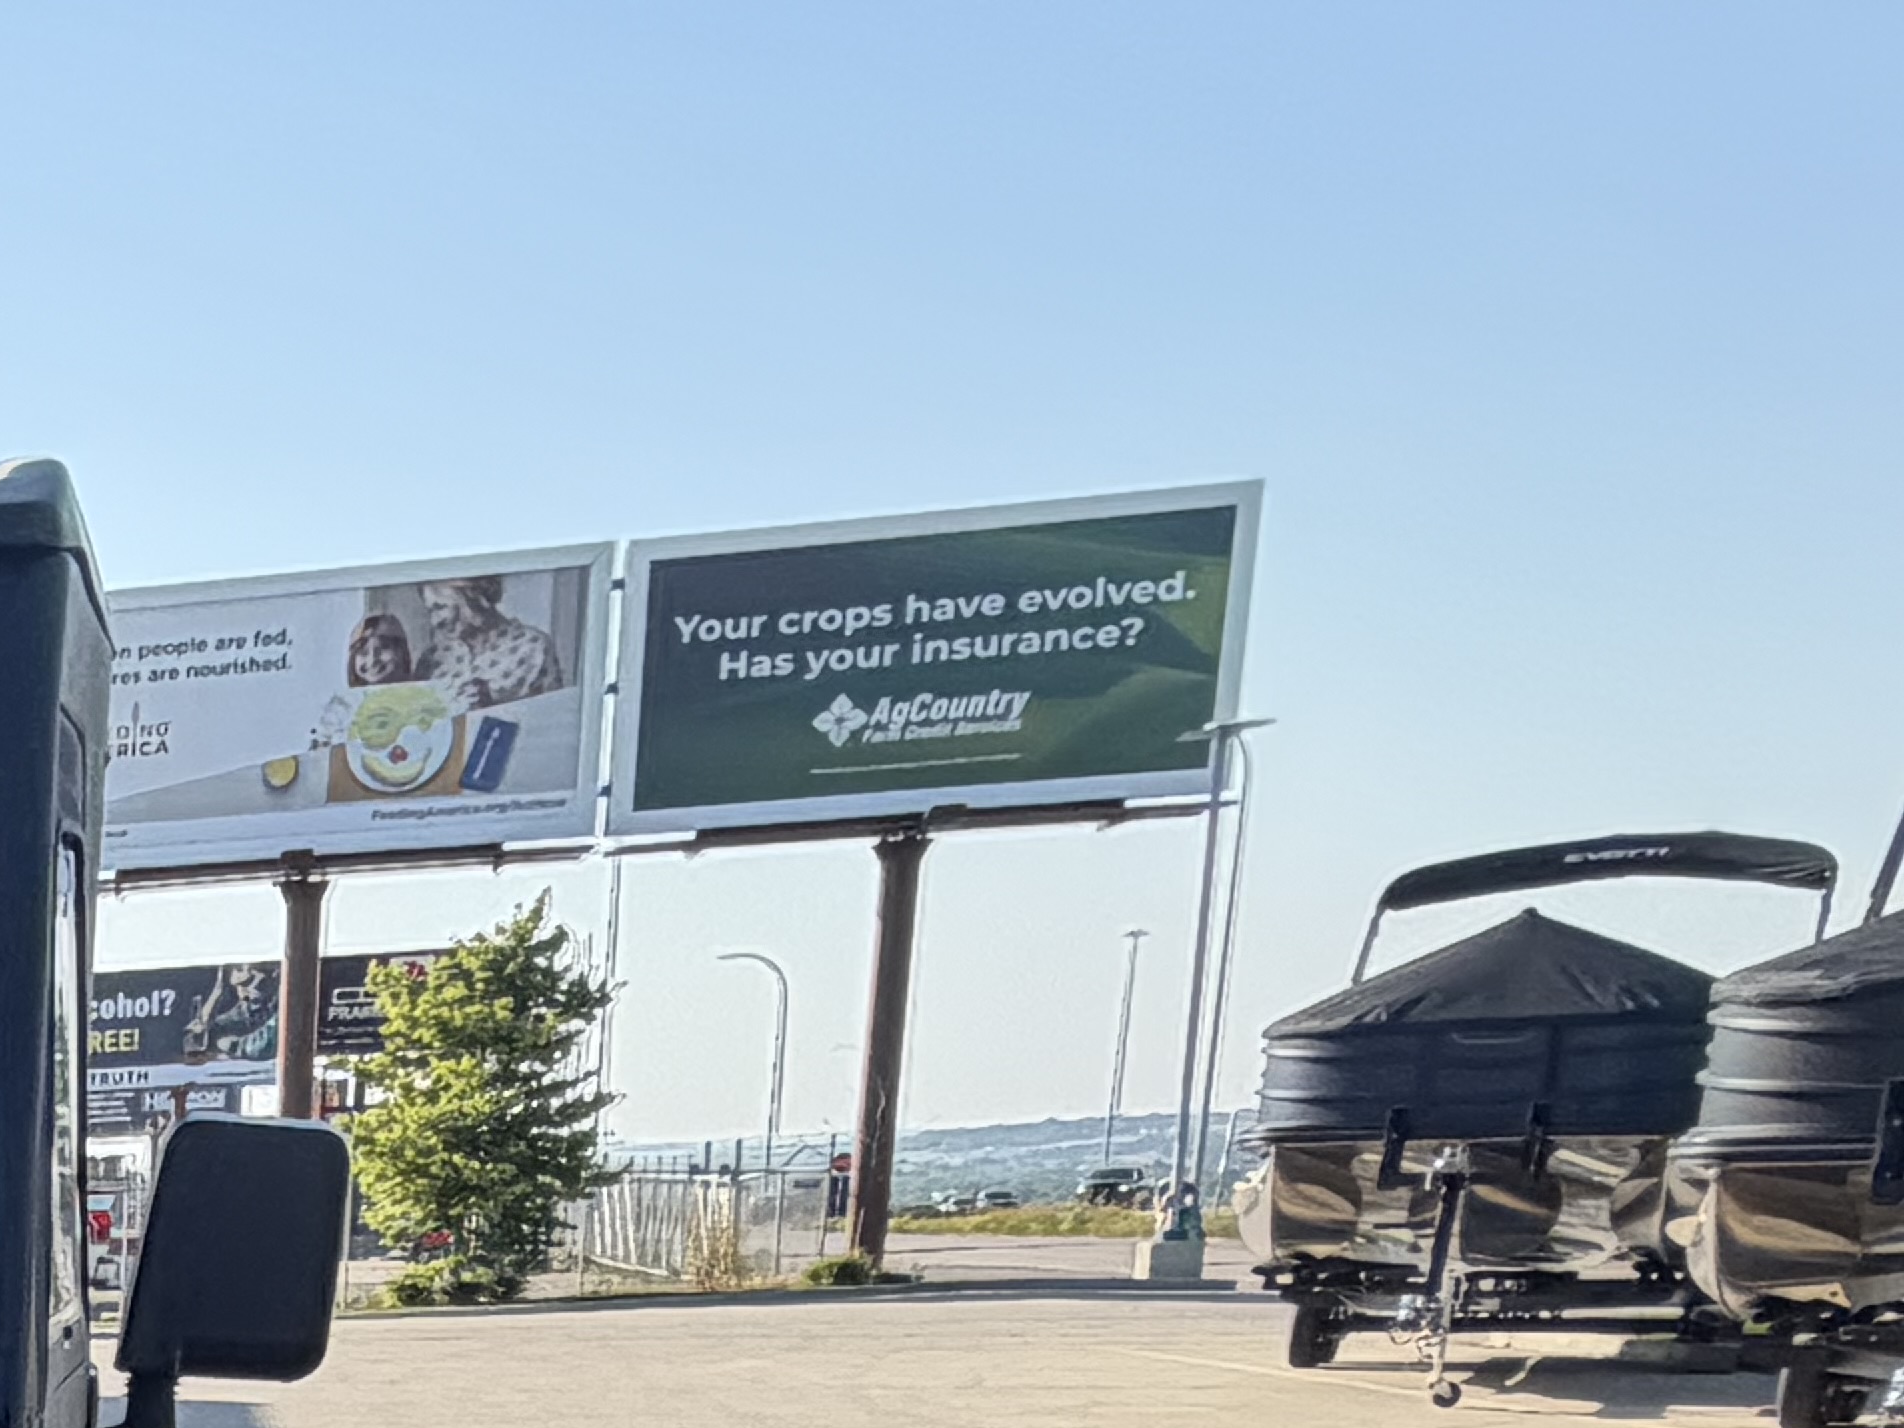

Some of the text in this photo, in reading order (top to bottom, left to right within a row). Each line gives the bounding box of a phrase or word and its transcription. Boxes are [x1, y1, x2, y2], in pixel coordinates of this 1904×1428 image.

[675, 570, 1197, 644] Your crops have evolved.
[138, 637, 208, 661] people
[215, 636, 247, 651] are
[718, 616, 1144, 680] Has your insurance?
[148, 666, 180, 683] are
[186, 653, 293, 679] nourished.
[869, 689, 1032, 728] AgCountry
